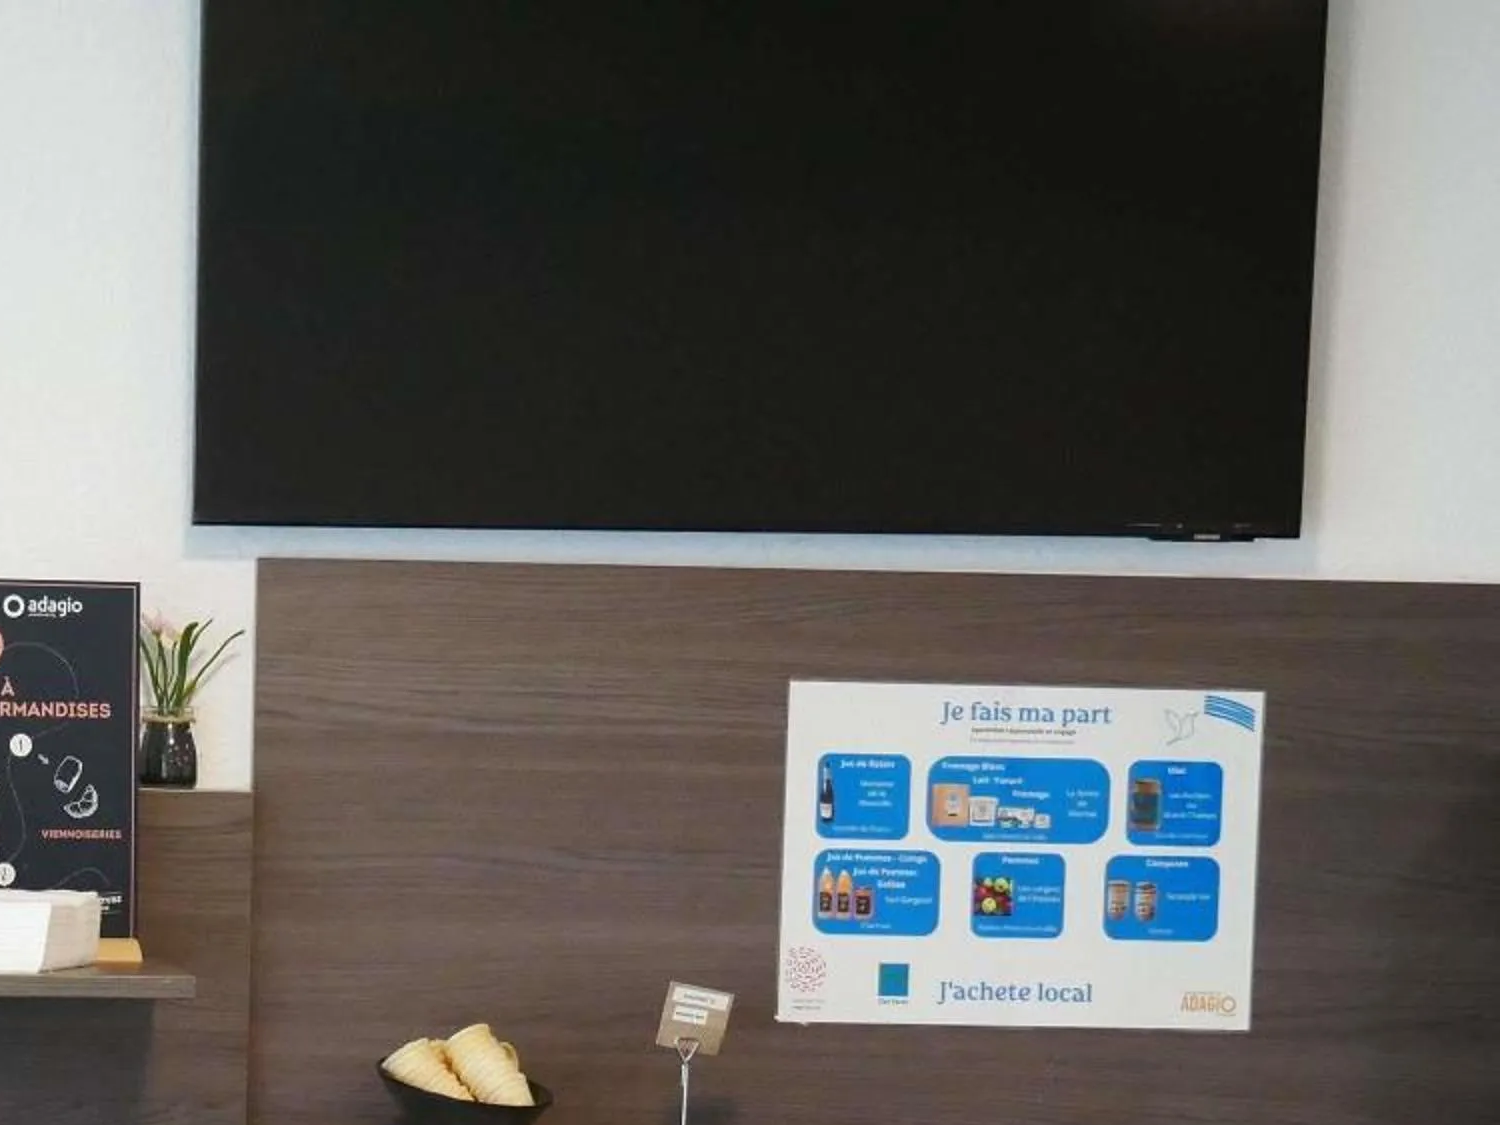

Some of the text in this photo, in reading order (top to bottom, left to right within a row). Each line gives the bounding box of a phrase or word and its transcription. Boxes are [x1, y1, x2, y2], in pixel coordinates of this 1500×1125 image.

[27, 595, 83, 618] adagio
[0, 675, 15, 697] À
[939, 700, 1112, 727] Je fais ma part
[41, 829, 122, 840] VIENNOISERIES
[936, 981, 1093, 1005] J'achete local
